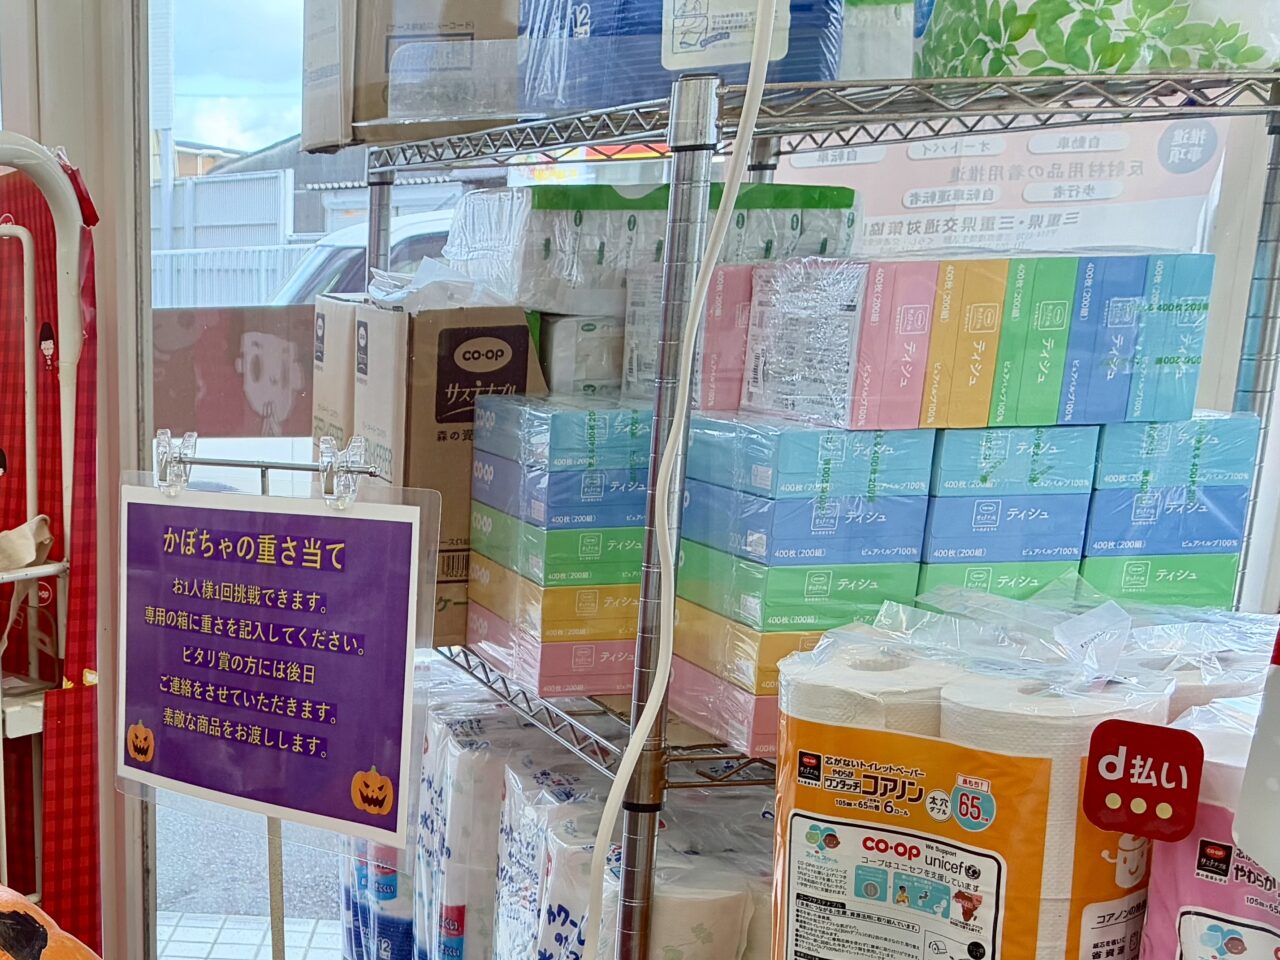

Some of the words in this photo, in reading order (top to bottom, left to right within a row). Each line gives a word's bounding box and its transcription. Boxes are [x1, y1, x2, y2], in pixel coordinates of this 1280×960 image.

[571, 3, 590, 28] 12
[845, 511, 887, 524] ティシュ
[1006, 507, 1049, 520] ティシュ
[163, 527, 346, 570] かぼちゃの重さ当て
[172, 577, 327, 614] お1人様1回挑戦できます。
[145, 605, 365, 656] 専用の箱に重さを記入してください。
[182, 646, 316, 684] ピタリ賞の方には後日
[159, 674, 337, 725] ご連絡をさせていただきます。
[163, 707, 327, 759] 素敵な商品をお渡しします。
[825, 756, 925, 777] 芯がないトイレットペーパー
[1098, 746, 1188, 790] d払い
[862, 774, 924, 803] コアノン
[925, 854, 964, 876] unicef
[935, 846, 957, 858] Support
[861, 856, 980, 892] コープはユニセフを支援しています
[1234, 864, 1277, 891] やわらか
